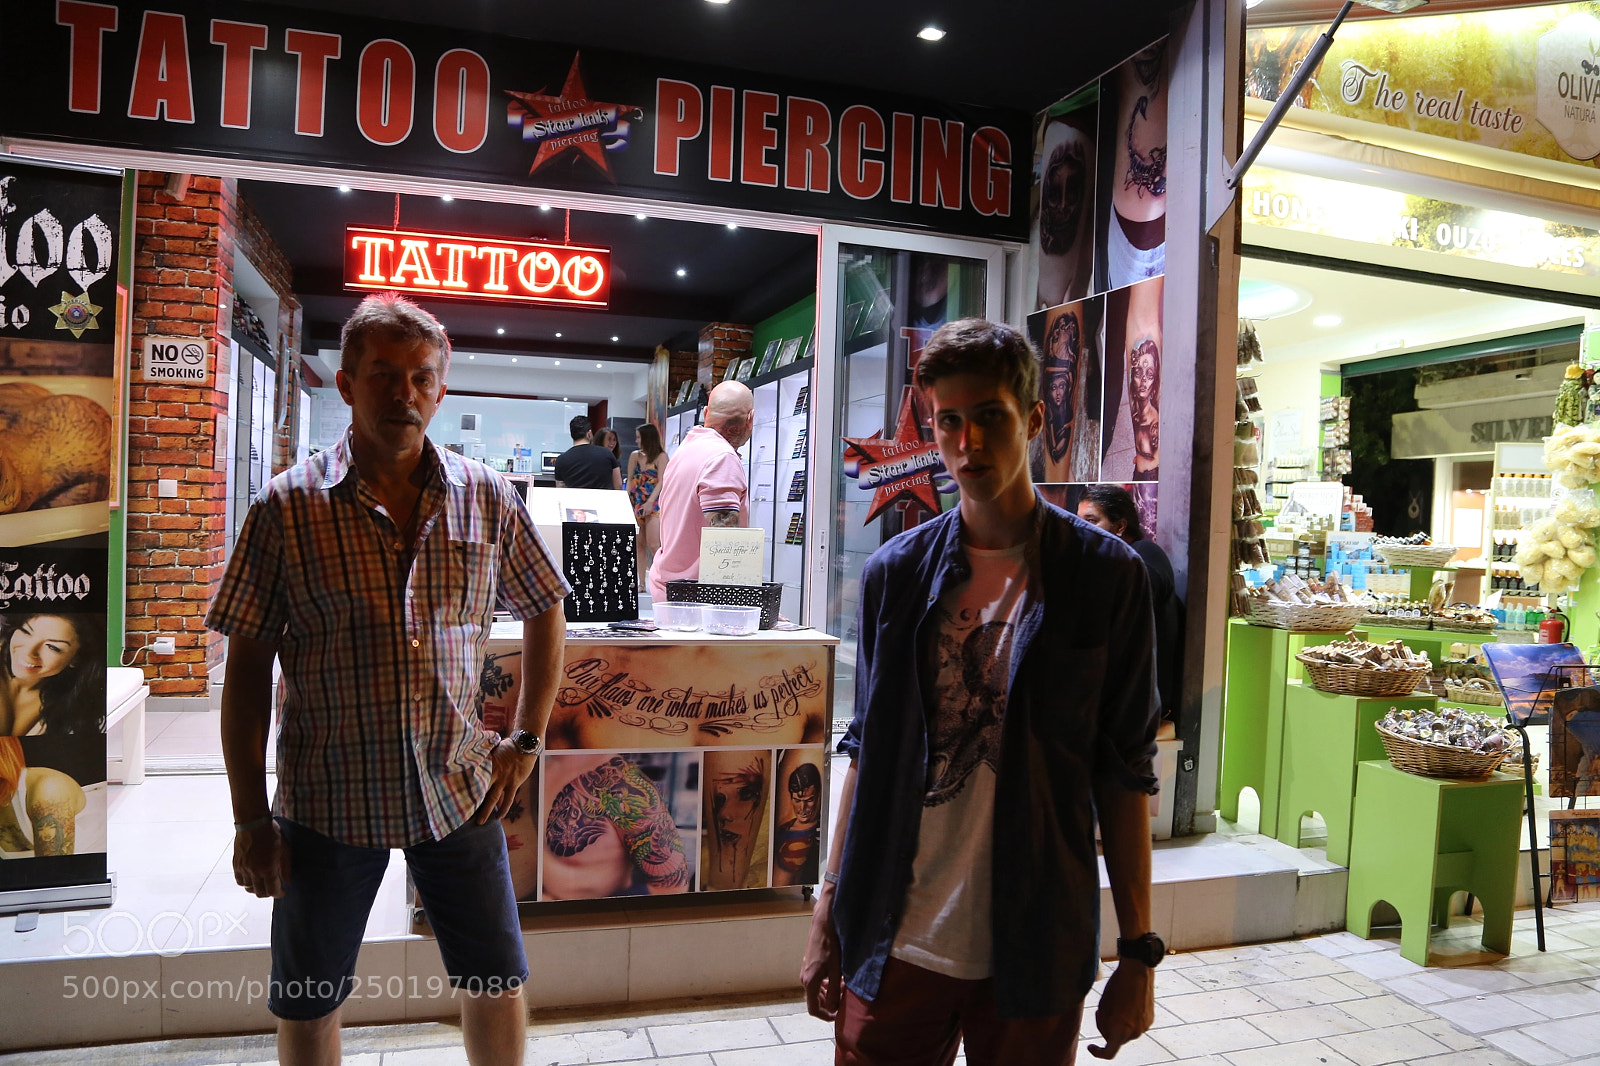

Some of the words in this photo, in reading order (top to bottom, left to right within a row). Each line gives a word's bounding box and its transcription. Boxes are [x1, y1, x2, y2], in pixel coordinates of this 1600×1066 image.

[54, 0, 491, 154] TATTOO
[548, 99, 587, 113] tattoo
[1340, 60, 1406, 111] The
[1415, 90, 1464, 122] real
[1470, 101, 1524, 135] taste
[533, 119, 575, 138] Star
[550, 132, 599, 151] piercing
[653, 77, 1013, 218] PIERCING
[1436, 222, 1496, 252] OUZO
[352, 235, 605, 297] TATTOO
[151, 344, 179, 361] NO
[150, 366, 204, 379] SMOKING
[881, 439, 920, 457] tattoo
[867, 460, 908, 485] Star
[884, 473, 931, 496] piercing
[709, 546, 732, 556] Special
[718, 559, 730, 569] 5
[564, 657, 610, 694] Our
[590, 672, 638, 705] flaws
[636, 692, 664, 714] are
[664, 686, 702, 720] what
[704, 684, 750, 719] makes
[753, 690, 769, 710] us
[770, 664, 815, 720] perfect
